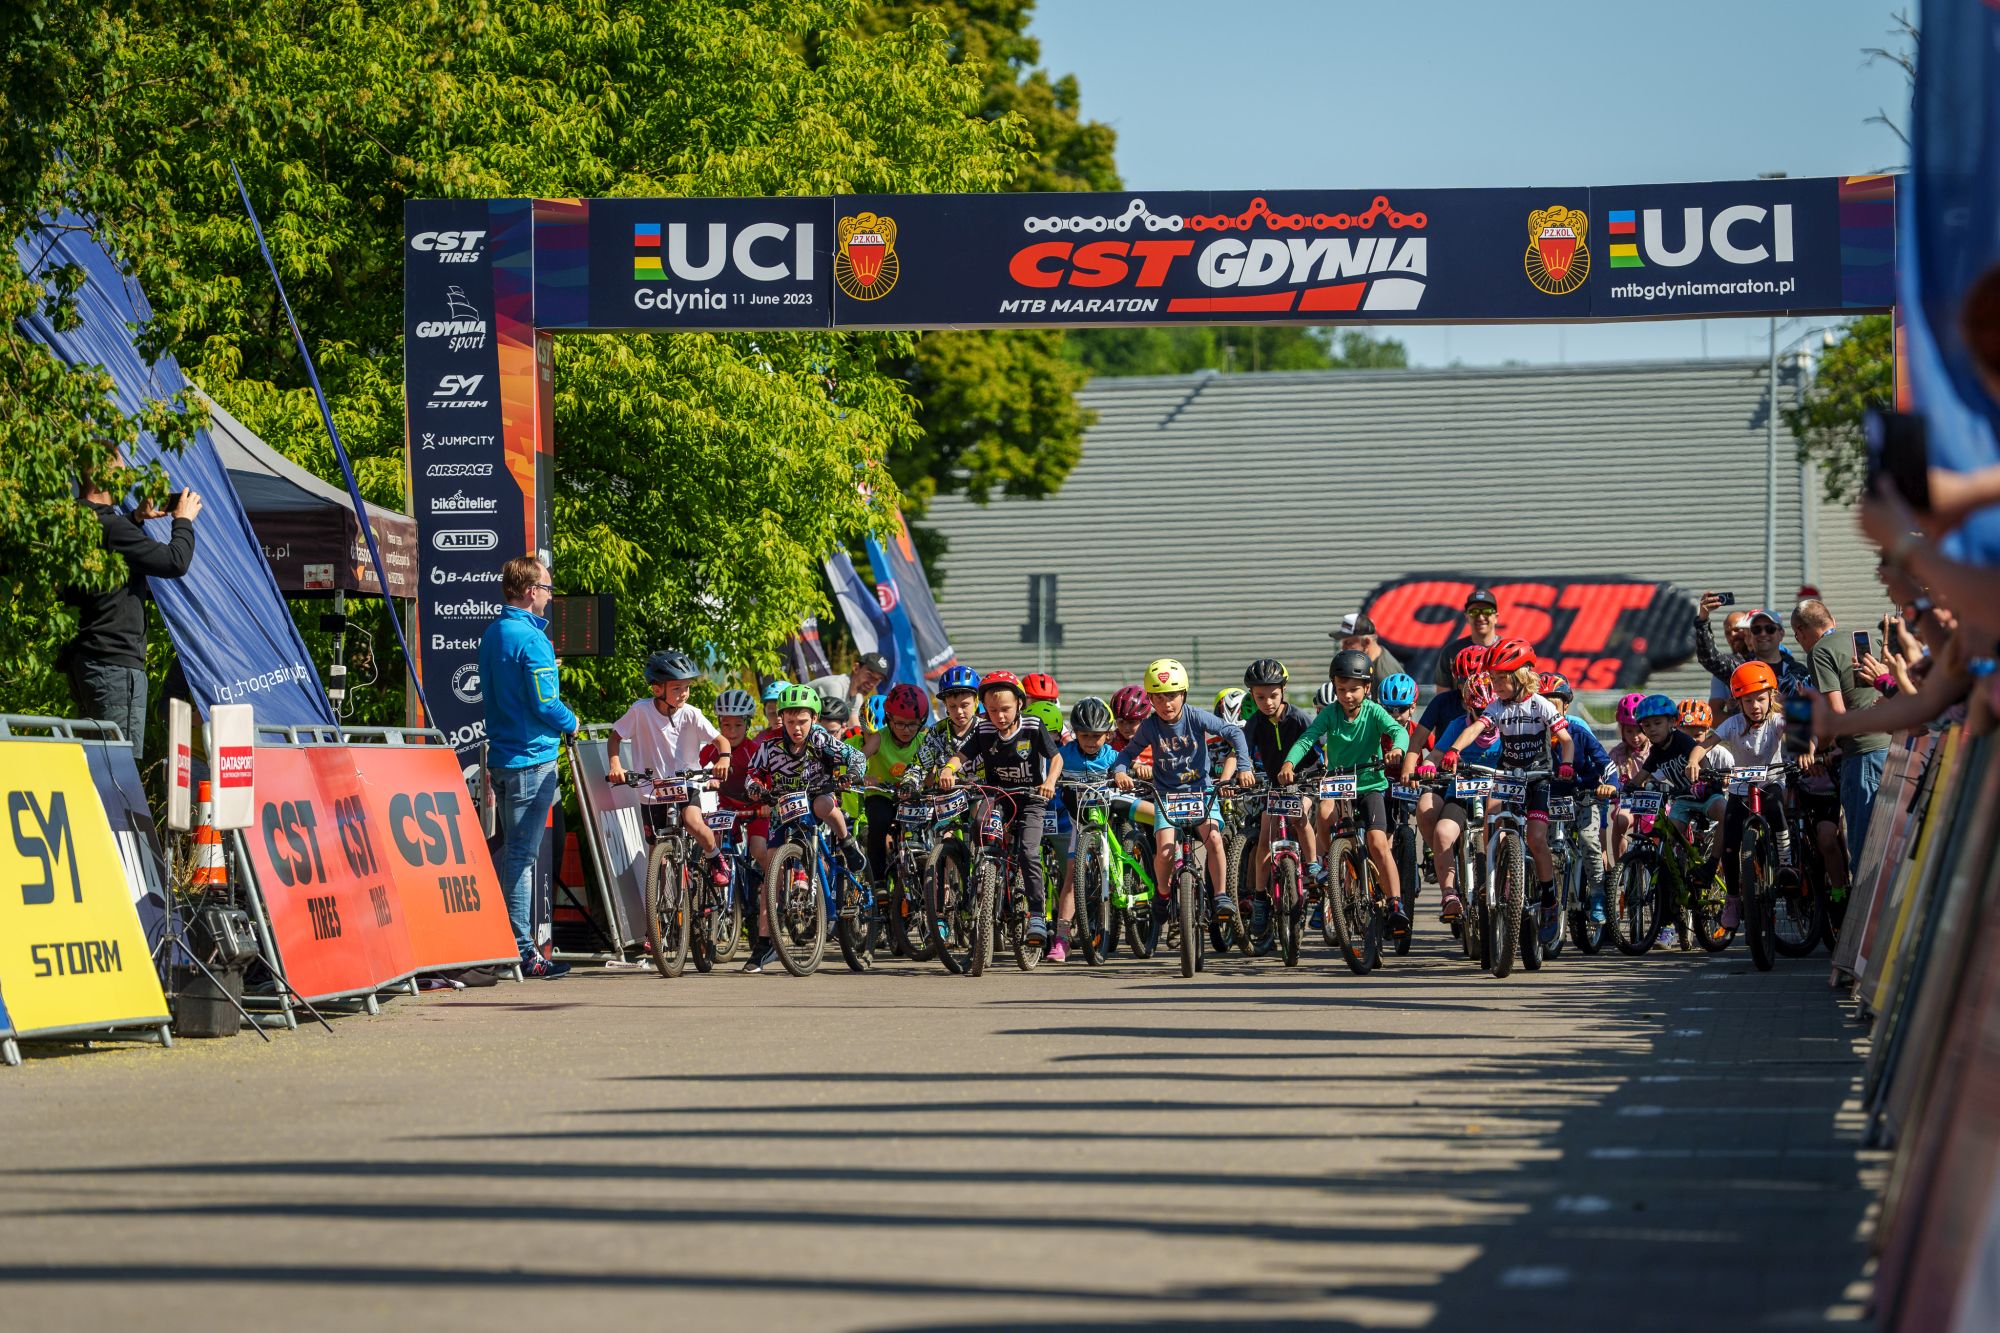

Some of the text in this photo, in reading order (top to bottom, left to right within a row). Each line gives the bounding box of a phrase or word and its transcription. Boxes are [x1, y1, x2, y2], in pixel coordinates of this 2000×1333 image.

[411, 230, 487, 251] CST
[1643, 204, 1794, 267] UCI
[438, 252, 480, 263] TIRES
[668, 222, 814, 282] UCI
[1008, 238, 1428, 289] CST GDYNIA
[1611, 277, 1795, 300] mtbgdyniamaraton.pl
[634, 287, 813, 315] Gdynia 11 June 2023
[999, 298, 1159, 313] MTB MARATON
[415, 320, 487, 339] GDYNIA
[448, 333, 487, 353] sport
[425, 400, 489, 409] STORM
[437, 435, 495, 446] JUMPCITY
[426, 463, 494, 477] AIRSPACE
[441, 534, 489, 546] ABUS
[446, 571, 504, 583] B-Active
[1368, 581, 1657, 653] CST
[449, 719, 487, 748] BOR
[220, 756, 252, 770] DATASPORT
[663, 786, 684, 796] 118
[1330, 783, 1353, 792] 180
[1466, 781, 1488, 790] 173
[1502, 784, 1523, 795] 137
[784, 799, 803, 811] 131
[945, 797, 964, 811] 132
[1177, 802, 1200, 812] 114
[1277, 800, 1299, 809] 166
[1640, 799, 1657, 808] 158
[908, 808, 925, 816] 174
[711, 815, 731, 824] 146
[389, 791, 467, 867] CST
[262, 800, 328, 887] CST
[335, 795, 378, 879] CST
[437, 874, 481, 914] TIRES
[369, 884, 393, 928] TIRES
[306, 896, 342, 941] TIRES
[31, 940, 123, 977] STORM
